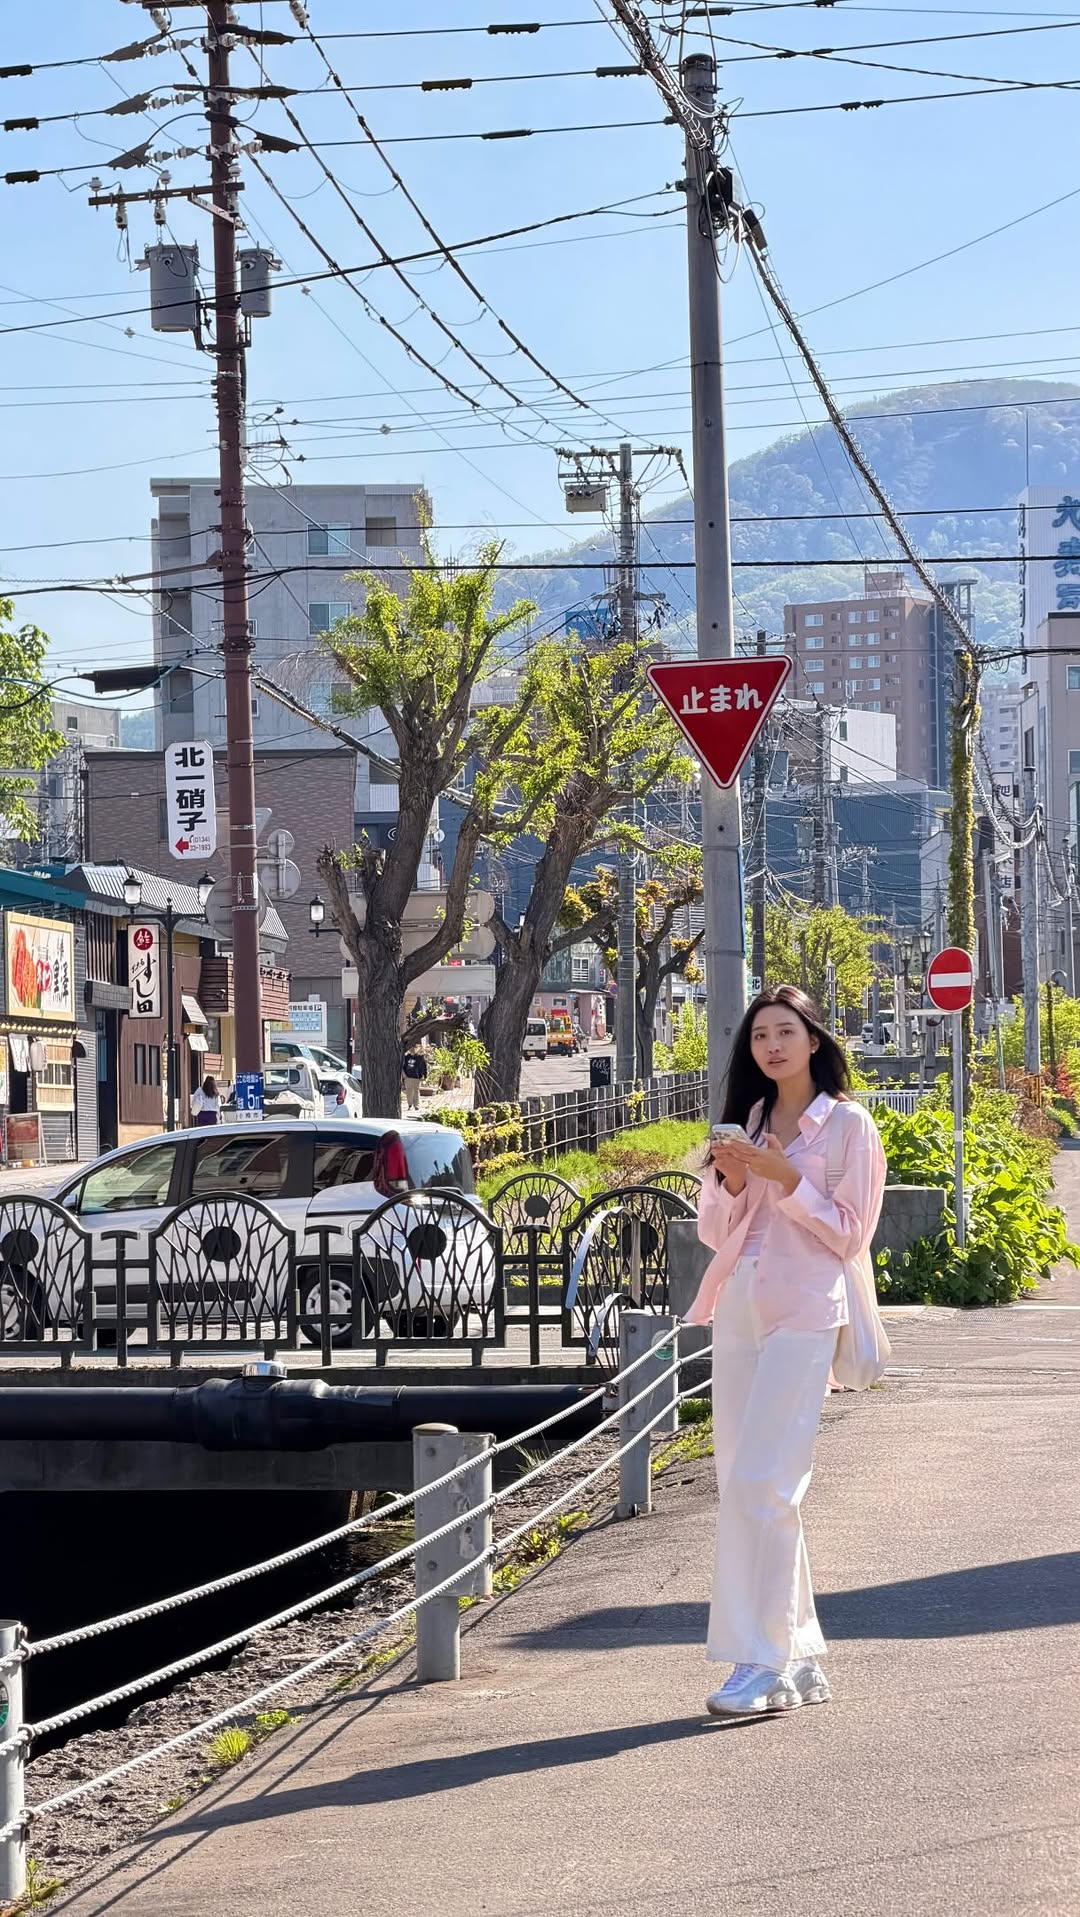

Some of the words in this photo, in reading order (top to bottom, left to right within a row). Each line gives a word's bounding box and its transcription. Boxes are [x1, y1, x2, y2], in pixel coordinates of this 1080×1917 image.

[680, 683, 762, 715] 止まれ
[175, 747, 207, 832] 北一硝子
